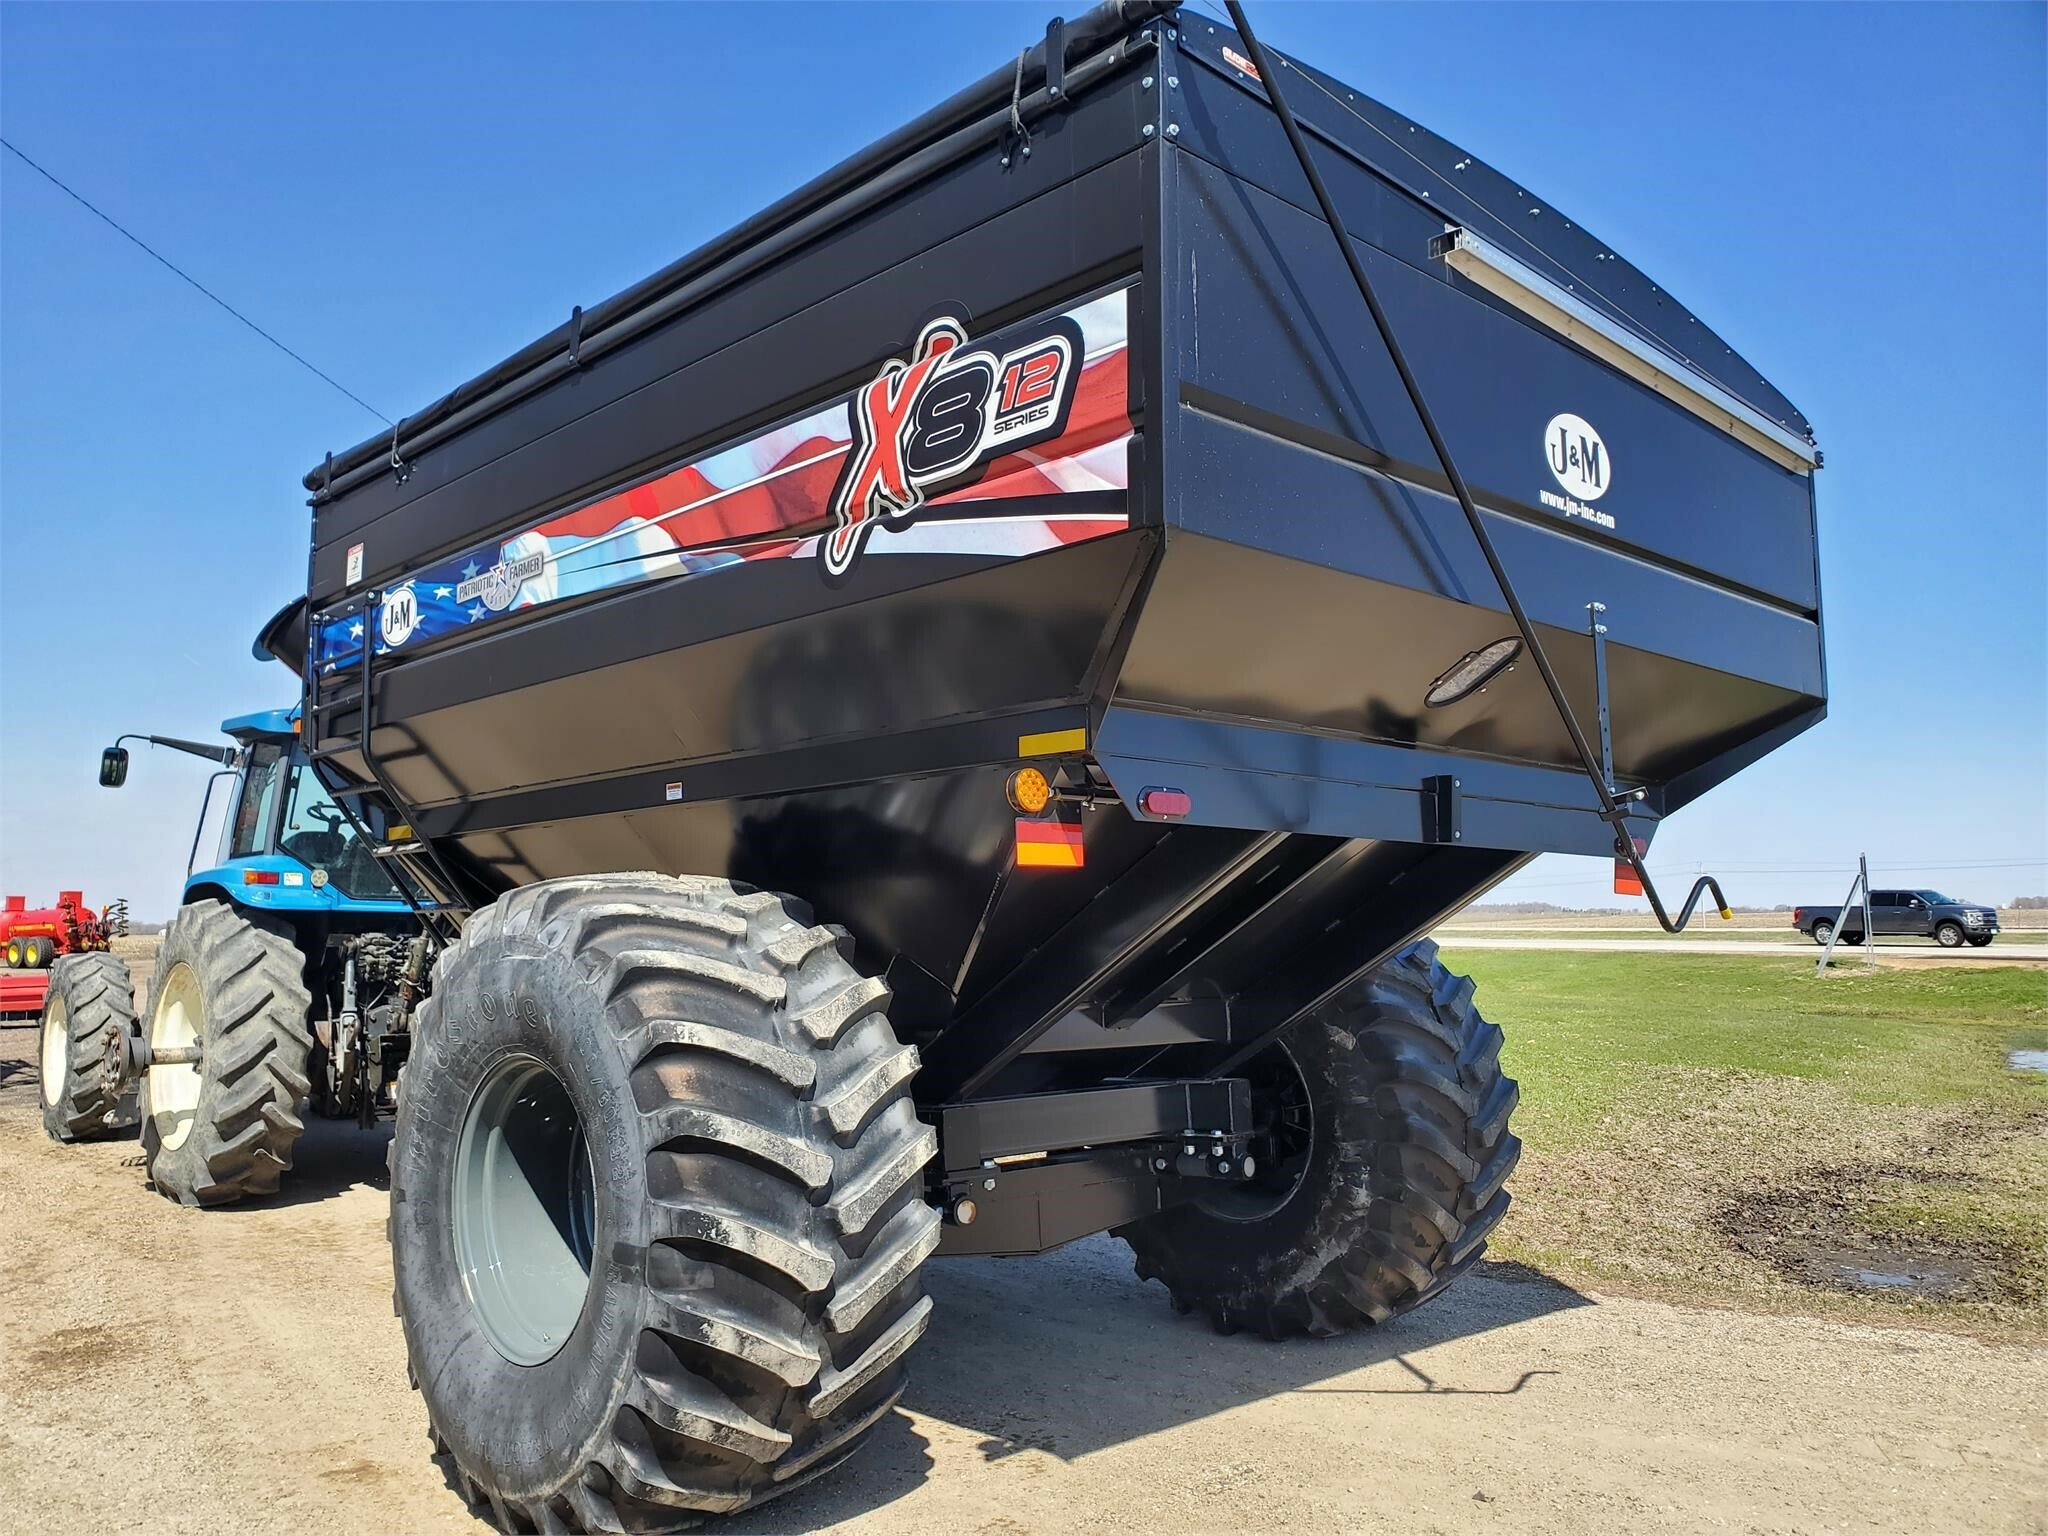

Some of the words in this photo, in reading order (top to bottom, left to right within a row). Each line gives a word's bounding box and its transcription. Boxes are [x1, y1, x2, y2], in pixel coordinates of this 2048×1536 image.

[993, 406, 1049, 435] SERIES
[1551, 427, 1601, 488] J&M
[1540, 489, 1615, 528] www.jm-inc.com
[458, 574, 493, 599] PATRIOTIC
[509, 557, 540, 581] FARMER
[385, 598, 411, 635] J&M
